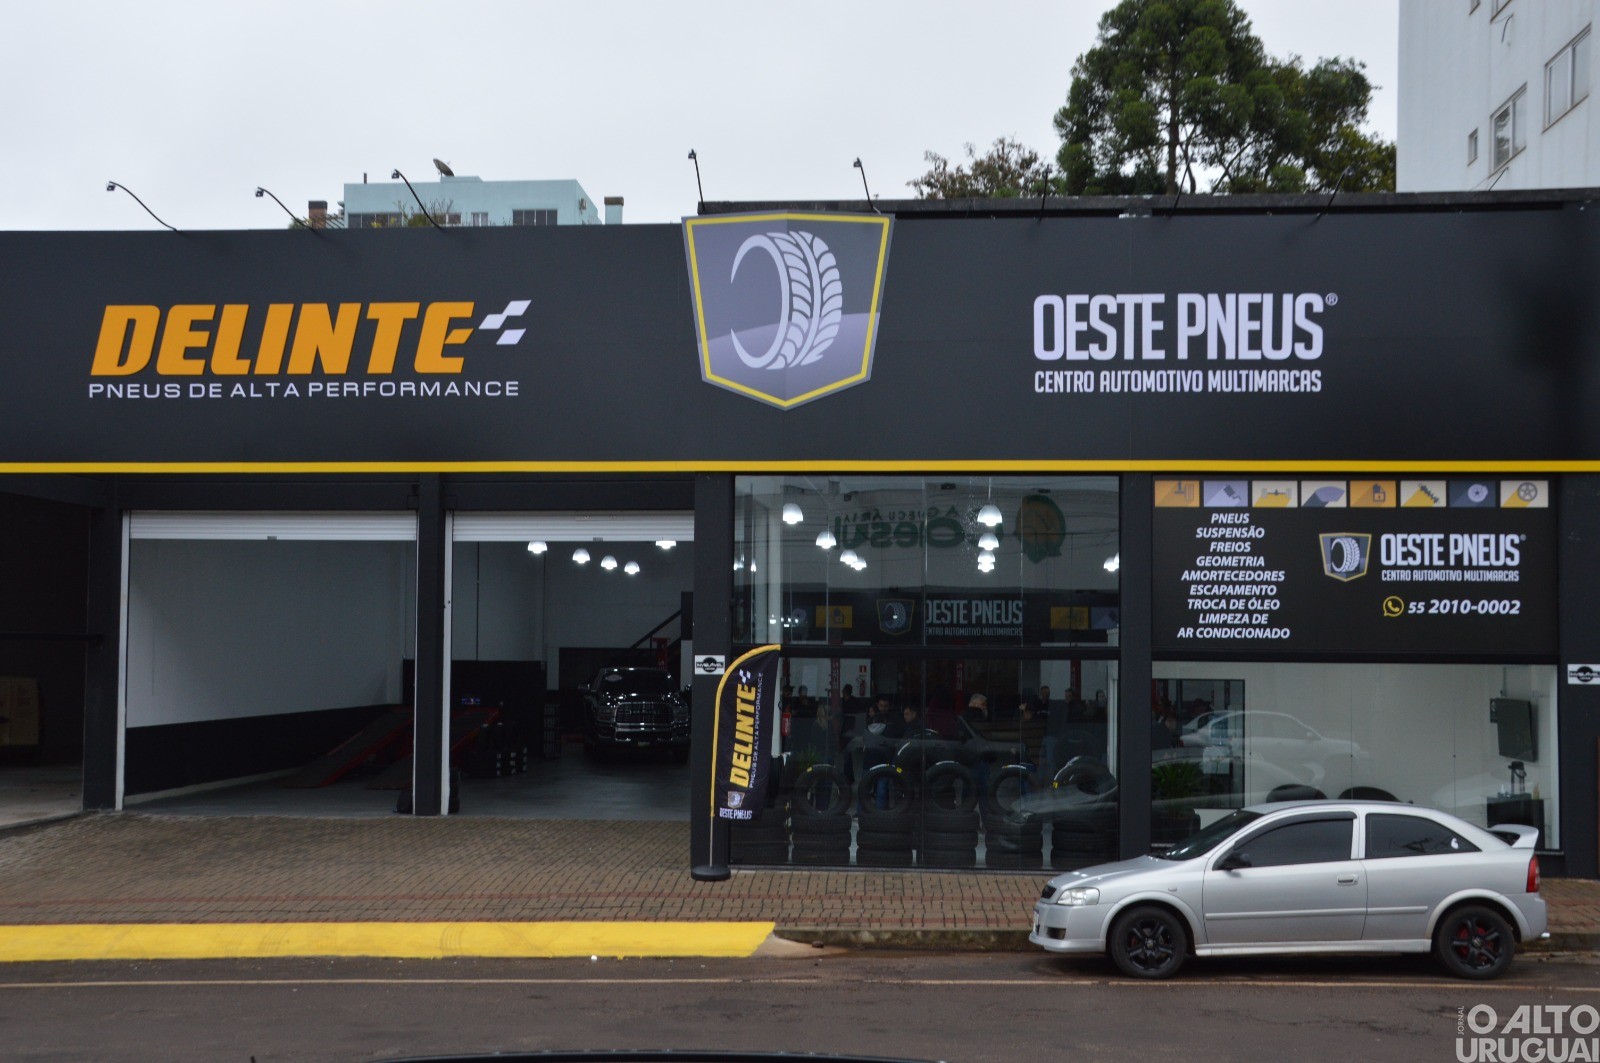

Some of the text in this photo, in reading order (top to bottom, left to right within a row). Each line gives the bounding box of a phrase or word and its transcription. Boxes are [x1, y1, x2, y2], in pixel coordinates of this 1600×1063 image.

[1034, 294, 1165, 360] OESTE
[91, 302, 474, 375] DELINTE
[1035, 370, 1321, 392] CENTRO AUTOMOTIVO MULTIMARCAS
[89, 381, 518, 398] PNEUS DE ALTA PERFORMANCE
[1211, 513, 1249, 524] PNEUS
[1196, 526, 1264, 538] SUSPENSÃO
[1210, 542, 1251, 552] FREIOS
[1381, 534, 1444, 565] OESTE
[1196, 556, 1264, 566] GEOMETRIA
[1181, 570, 1284, 581] AMORTECEDORES
[1382, 570, 1519, 581] CENTRO AUTOMOTIVO MULTIMARCAS
[1190, 585, 1276, 595] ESCAPAMENTO
[1188, 597, 1280, 610] TROCA DE ÓLEO
[1408, 599, 1520, 614] 55 2010-0002
[972, 600, 1022, 624] PNEUS
[1199, 613, 1268, 624] LIMPEZA DE
[1177, 628, 1290, 638] AR CONDICIONADO
[730, 683, 755, 788] DELINTE
